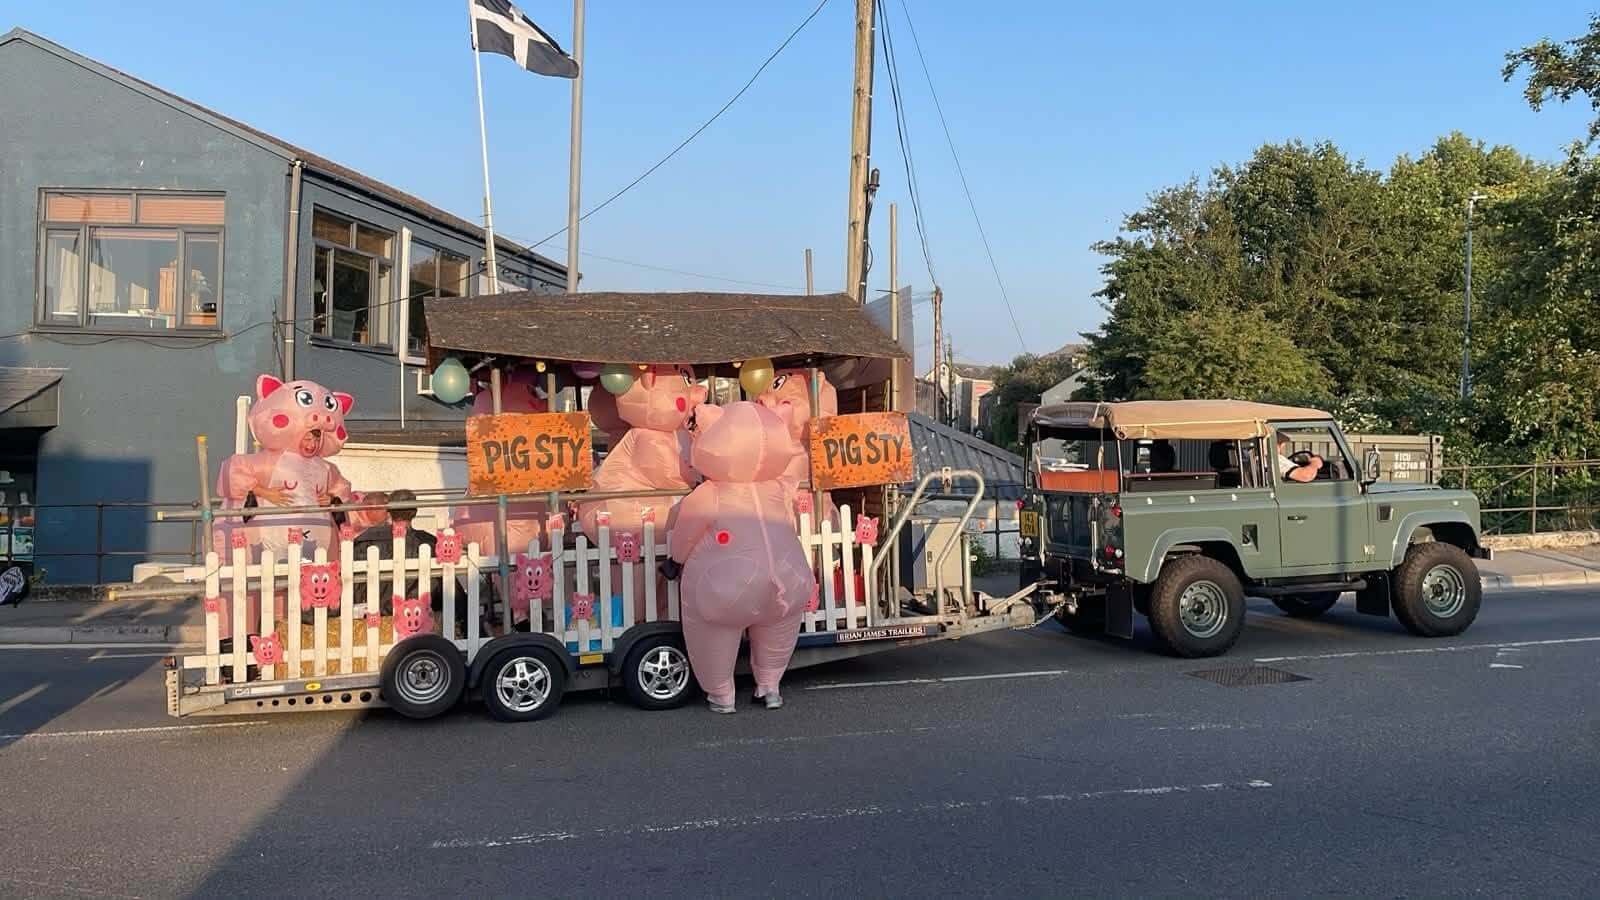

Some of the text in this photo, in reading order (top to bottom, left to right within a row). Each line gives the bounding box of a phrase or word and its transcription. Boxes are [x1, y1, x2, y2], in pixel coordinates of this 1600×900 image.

[481, 433, 585, 474] PIG STY
[823, 431, 904, 469] PIG STY
[840, 631, 861, 641] BRIAN
[863, 630, 886, 639] JAMES
